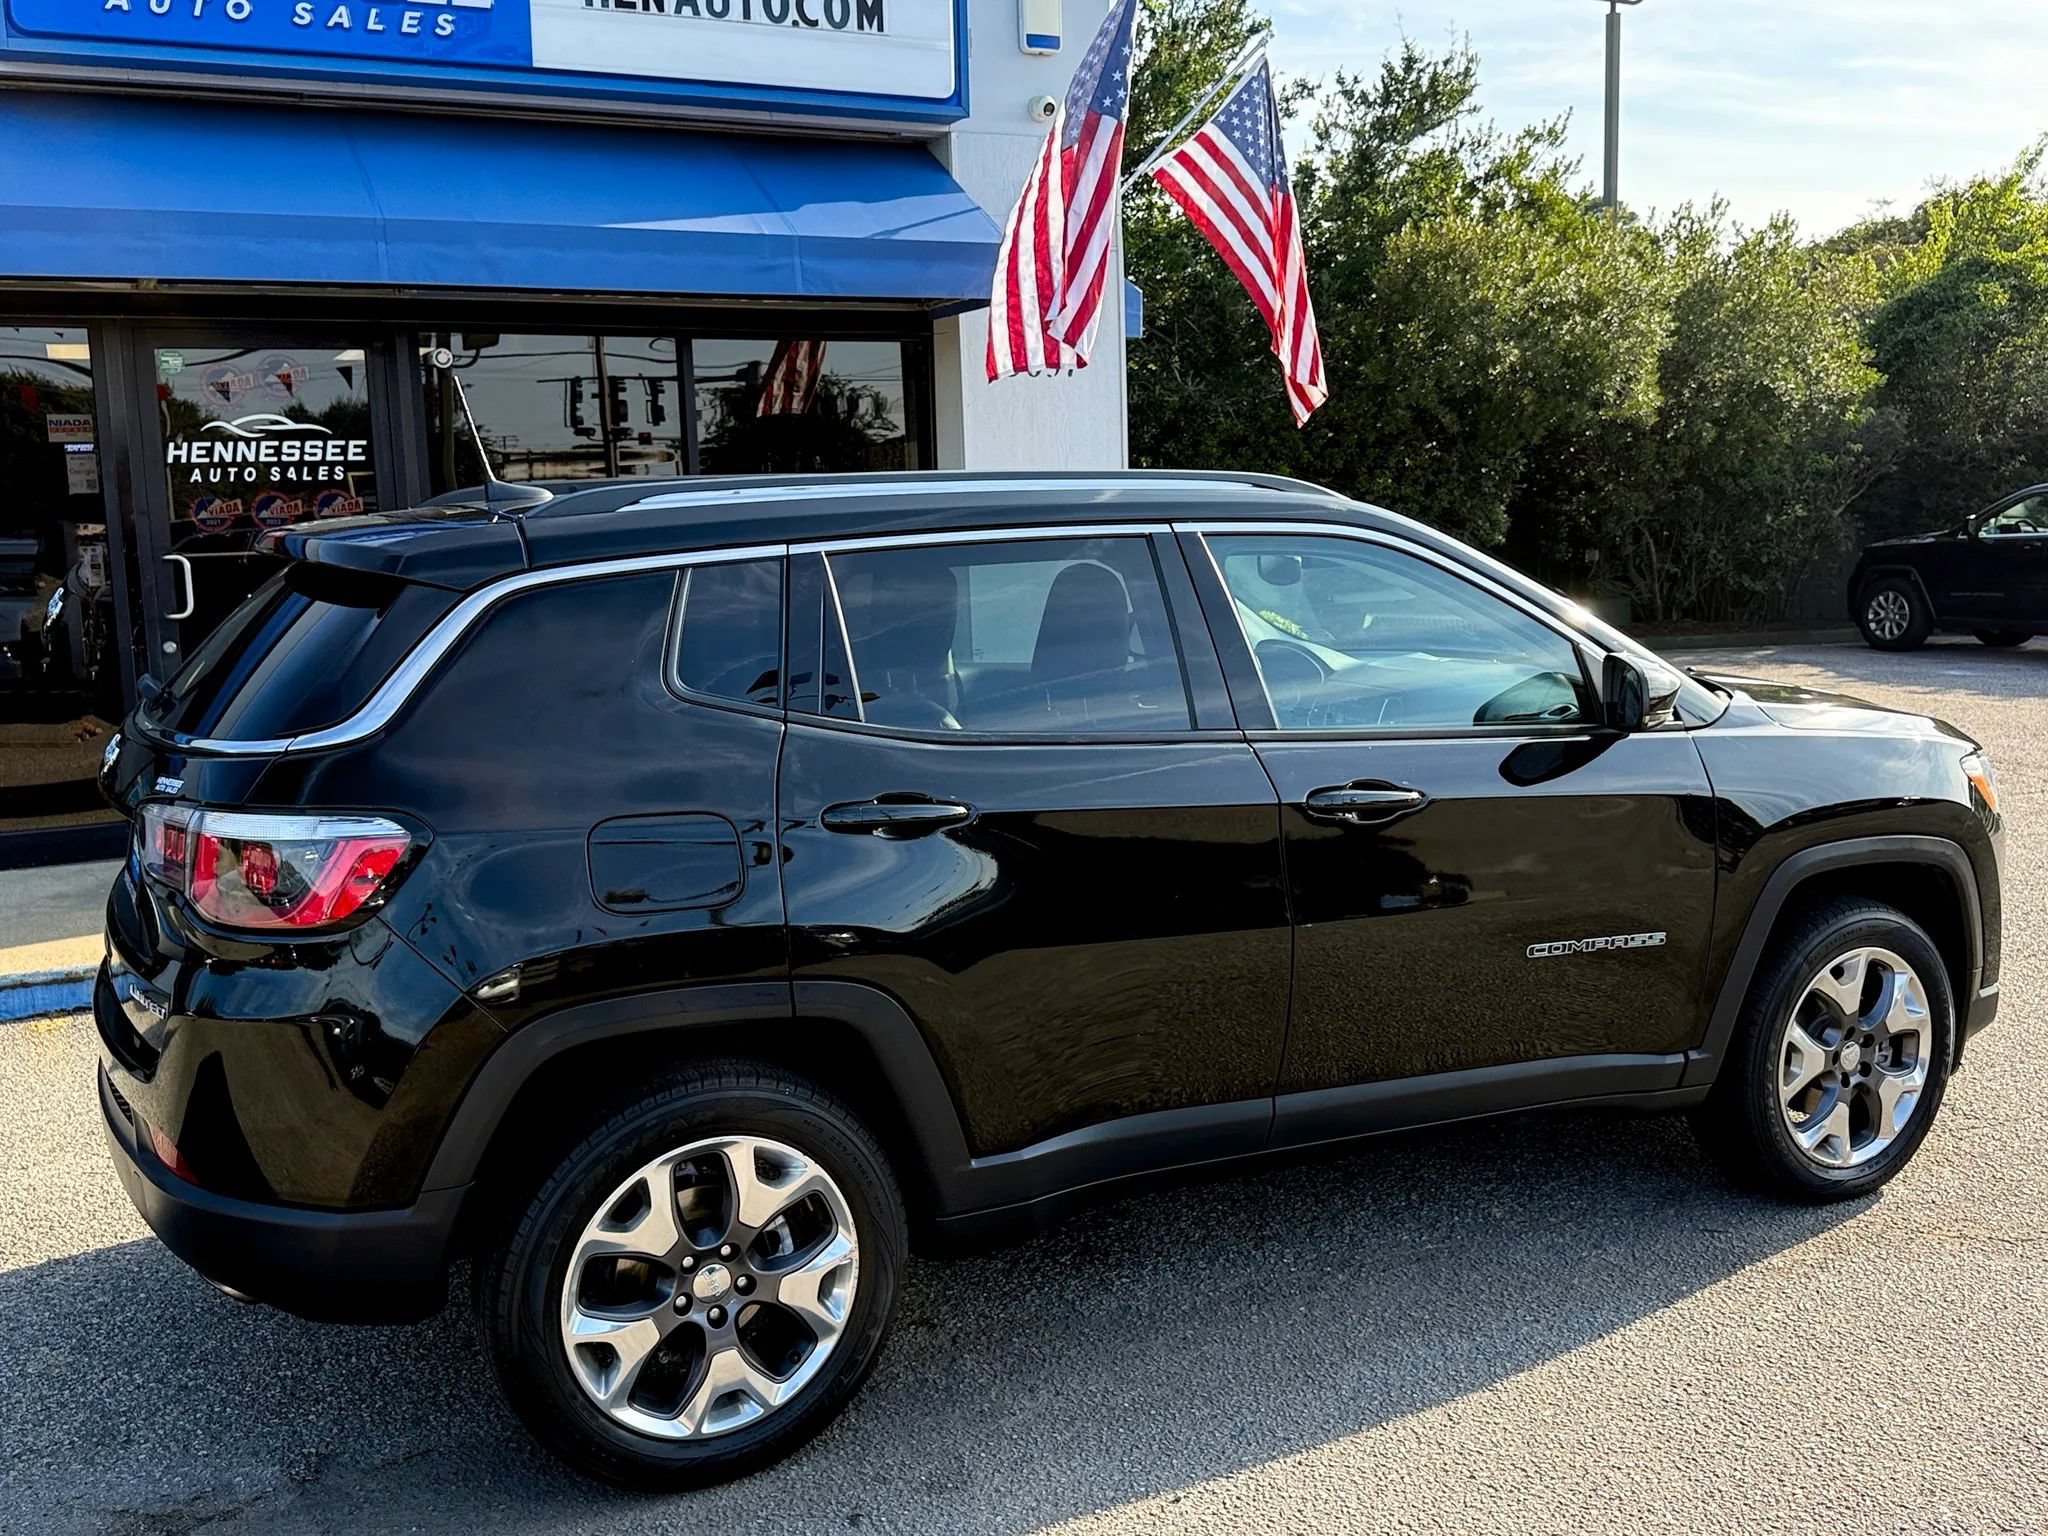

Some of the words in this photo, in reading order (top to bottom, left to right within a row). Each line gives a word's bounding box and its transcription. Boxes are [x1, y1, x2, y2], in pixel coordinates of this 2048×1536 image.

[292, 2, 456, 36] SALES
[167, 440, 367, 463] HENNESSEE
[190, 467, 256, 482] AUTO
[269, 466, 345, 482] SALES
[208, 502, 240, 516] VIADA
[269, 502, 300, 516] VIADA
[331, 500, 362, 513] VIADA
[1527, 932, 1666, 957] COMPASS
